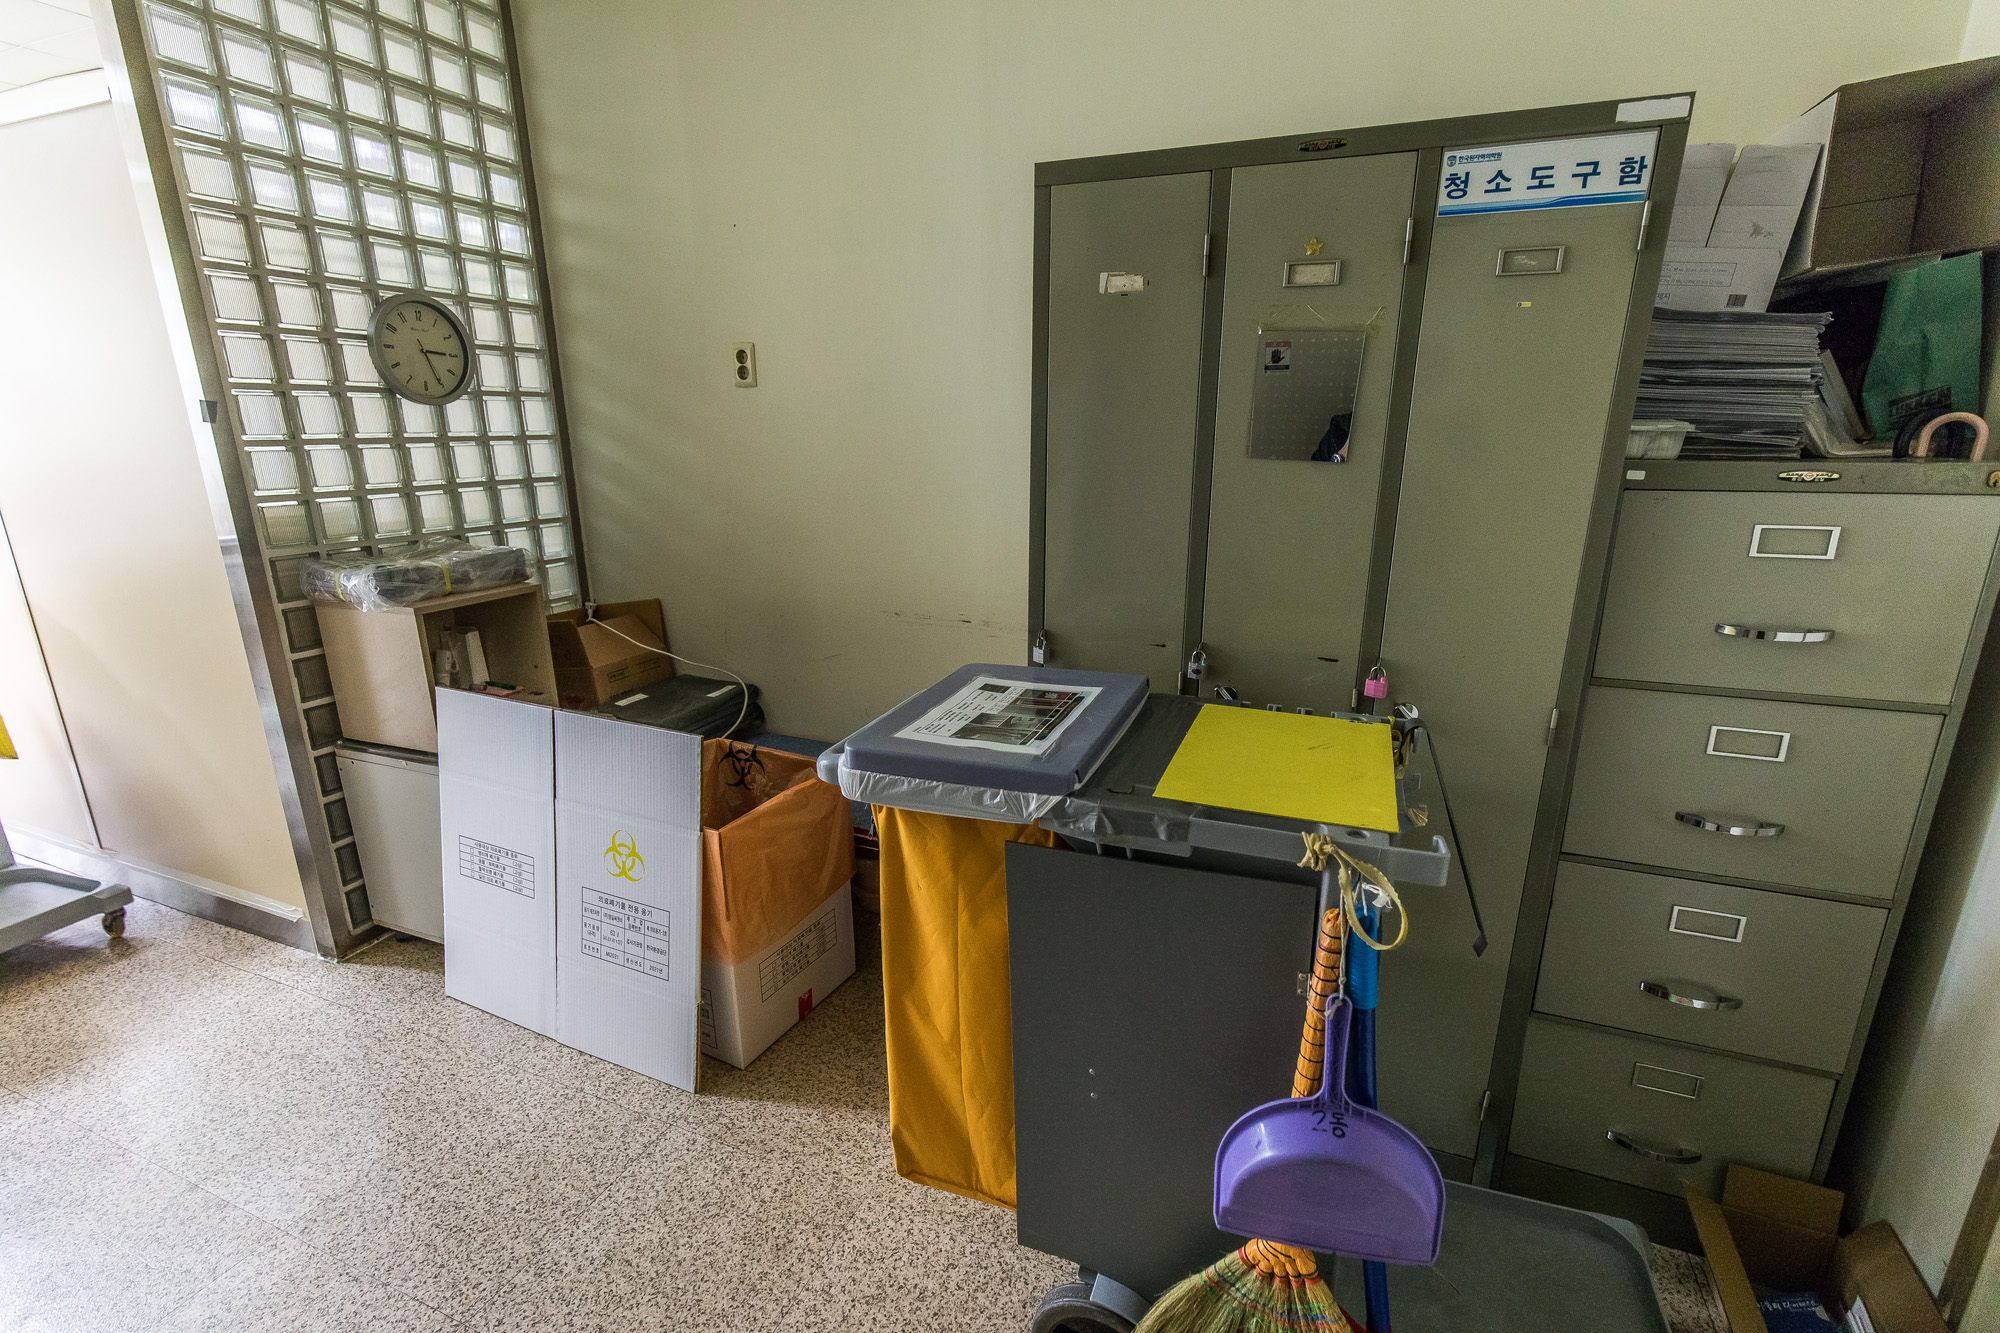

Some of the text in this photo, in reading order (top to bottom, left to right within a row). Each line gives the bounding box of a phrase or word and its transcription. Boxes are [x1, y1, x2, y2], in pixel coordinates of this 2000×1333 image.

[1458, 152, 1502, 162] 한국원자력의학원
[414, 310, 422, 322] 12
[598, 896, 652, 918] 의료폐기물 전용 용기
[646, 944, 667, 956] 한국환경공단
[650, 965, 663, 974] 2021년
